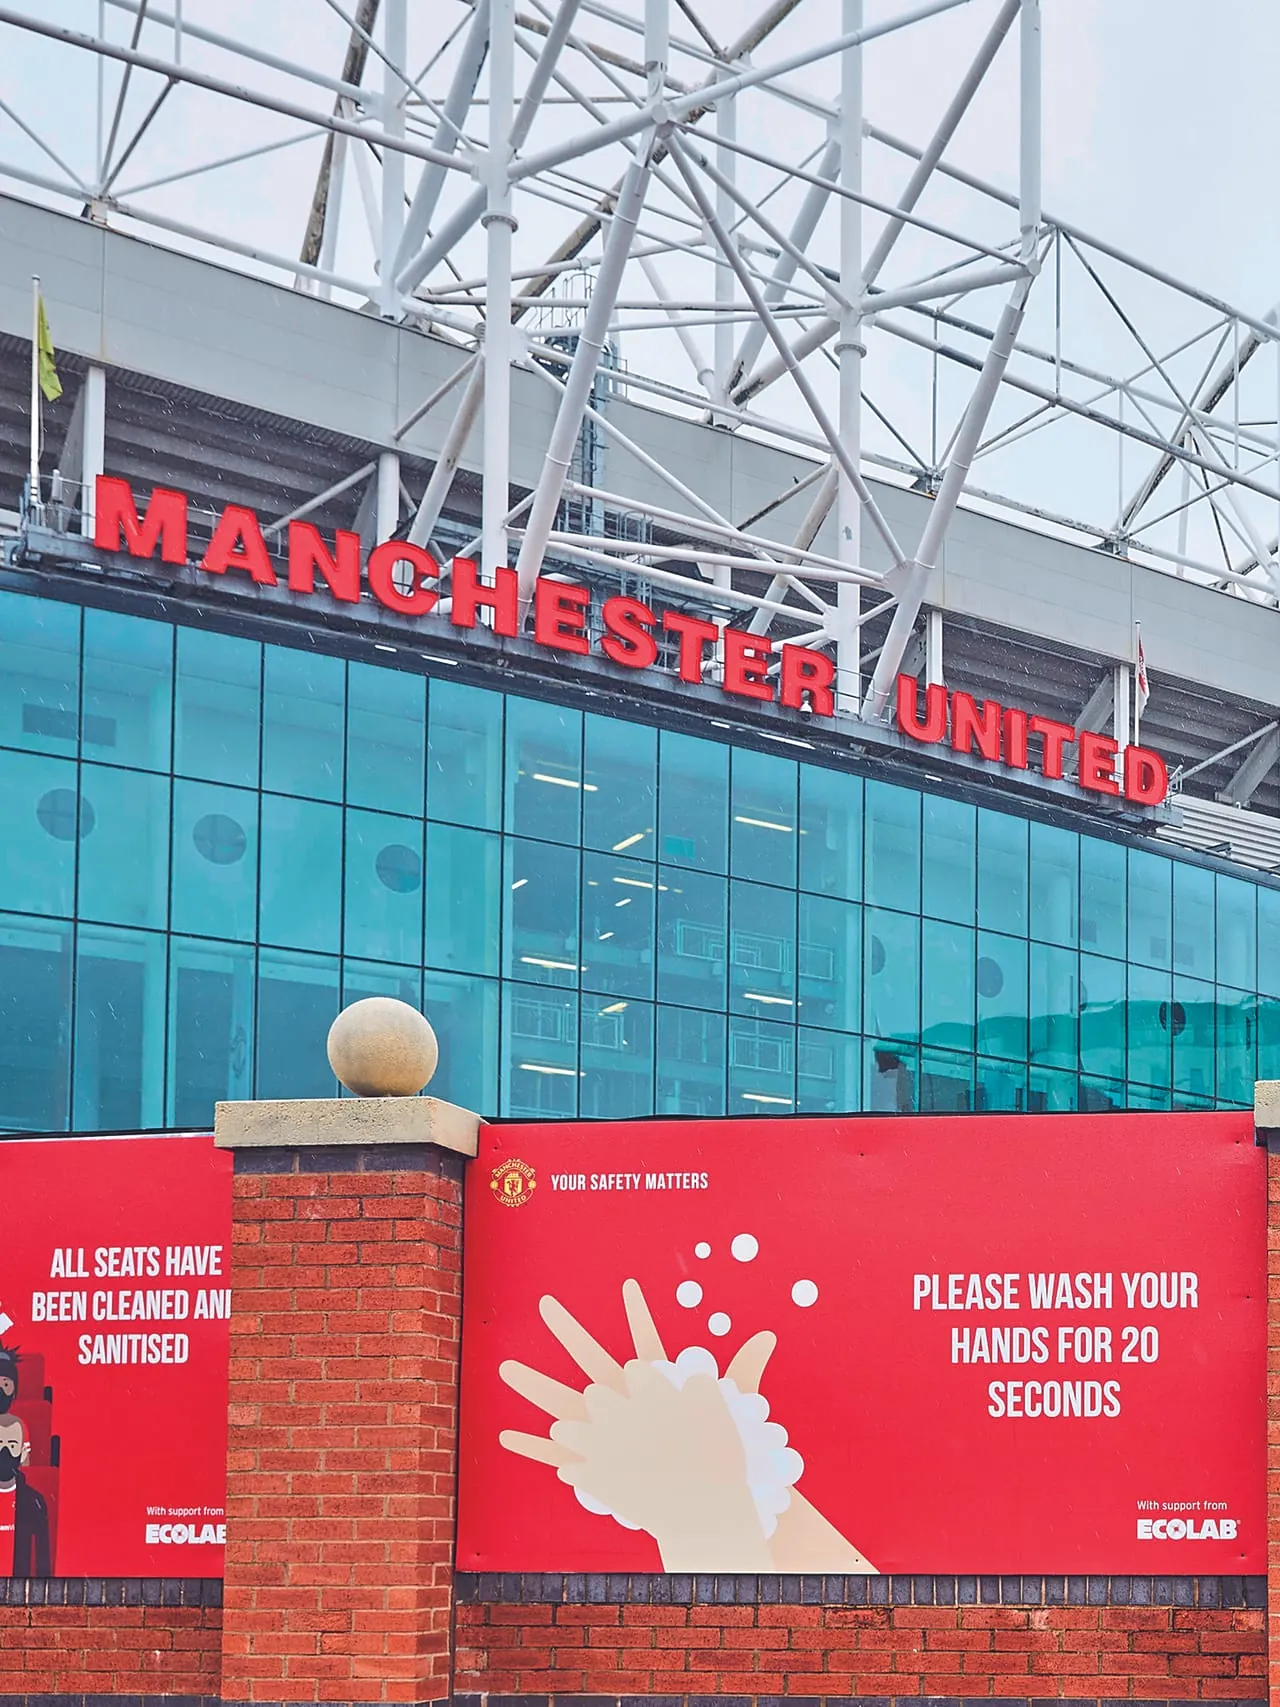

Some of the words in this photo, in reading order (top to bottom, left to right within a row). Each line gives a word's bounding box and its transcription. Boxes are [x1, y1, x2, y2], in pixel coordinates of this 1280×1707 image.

[93, 474, 836, 717] MANCHESTER
[897, 673, 1169, 807] UNITED
[551, 1174, 587, 1191] YOUR
[590, 1173, 642, 1191] SAFETY
[645, 1172, 709, 1190] MATTERS
[500, 1194, 527, 1205] UNITED
[50, 1248, 90, 1278] ALL
[94, 1246, 161, 1278] SEATS
[165, 1245, 223, 1277] HAVE
[31, 1291, 88, 1322] BEEN
[92, 1289, 189, 1321] CLEANED
[913, 1274, 1021, 1311] PLEASE
[1027, 1273, 1113, 1310] WASH
[1120, 1271, 1199, 1309] YOUR
[77, 1333, 189, 1365] SANITISED
[951, 1327, 1049, 1364] HANDS
[1057, 1327, 1113, 1364] FOR
[1121, 1326, 1159, 1363] 20
[987, 1381, 1121, 1418] SECONDS
[146, 1506, 167, 1516] With
[168, 1507, 202, 1518] support
[203, 1506, 225, 1516] from
[1137, 1500, 1160, 1511] With
[1162, 1501, 1201, 1512] support
[1203, 1500, 1228, 1511] from
[1137, 1518, 1237, 1541] ECOLAB
